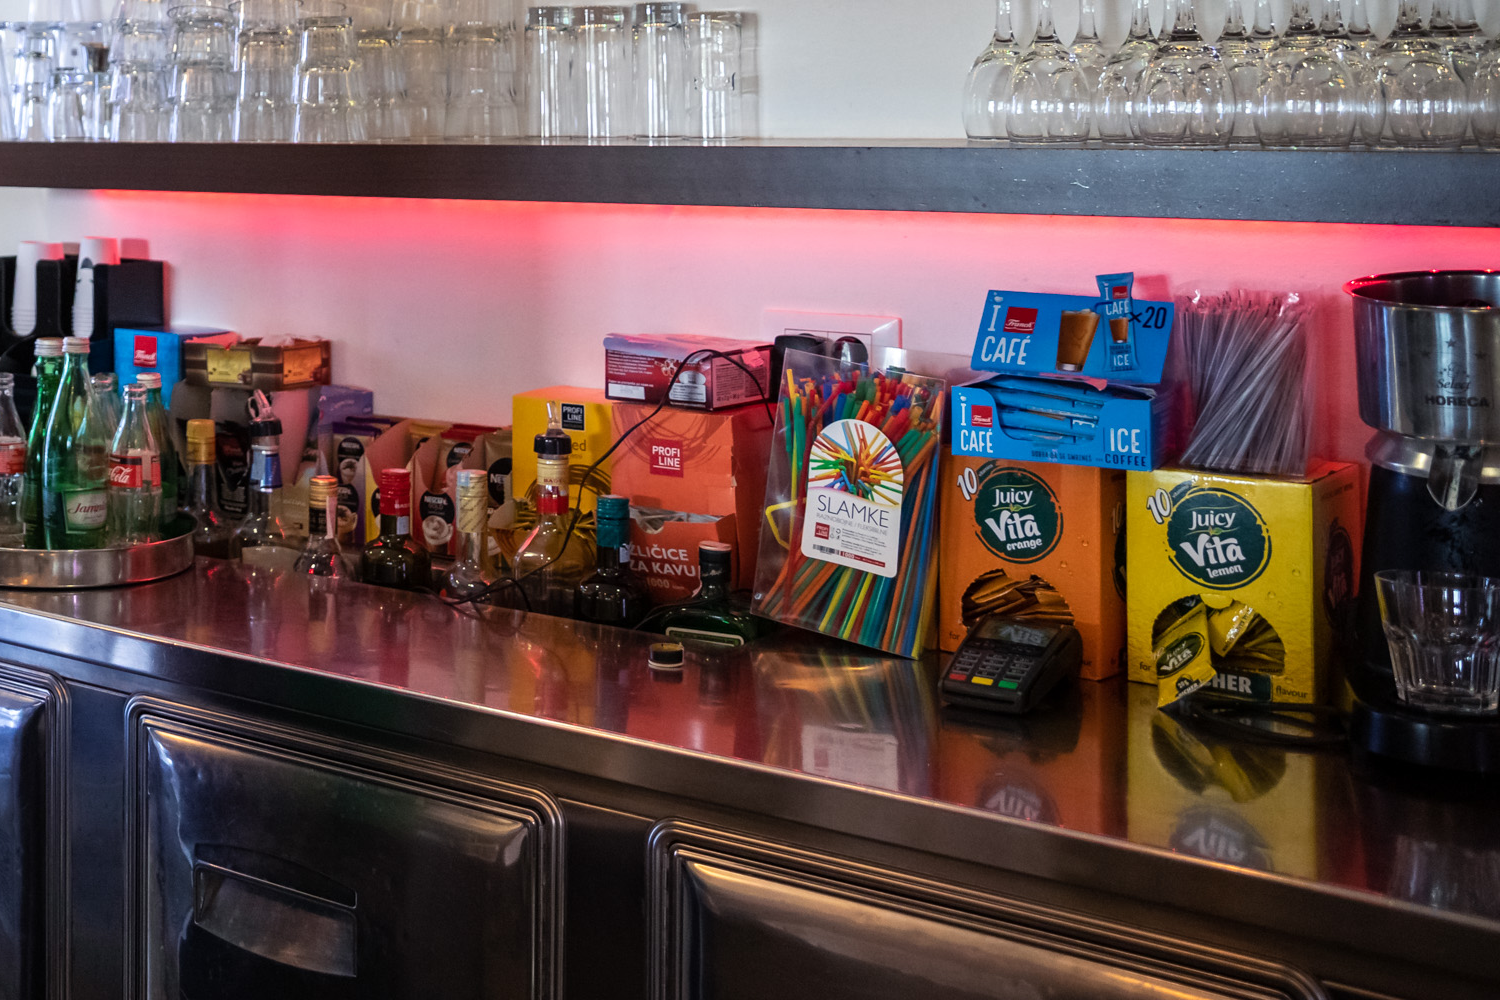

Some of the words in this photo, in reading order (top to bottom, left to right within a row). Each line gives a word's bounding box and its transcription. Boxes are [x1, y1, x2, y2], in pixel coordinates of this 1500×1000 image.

[981, 335, 1032, 366] CAFÉ
[1113, 354, 1130, 366] ICE
[1425, 395, 1489, 407] HORECA
[563, 406, 583, 414] PROFI
[567, 413, 583, 422] LINE
[960, 429, 994, 453] CAFÉ
[1110, 428, 1141, 453] ICE
[652, 445, 680, 458] PROFI
[658, 455, 681, 468] LINE
[1105, 453, 1147, 467] COFFEE
[957, 467, 978, 500] 10
[992, 489, 1034, 507] Juicy
[818, 494, 890, 529] SLAMKE
[1147, 488, 1172, 524] 10
[984, 510, 1042, 543] Vita
[1188, 511, 1236, 530] Juicy
[1006, 537, 1043, 551] orange
[1180, 533, 1246, 566] Vita
[652, 562, 696, 577] KAVU
[1206, 564, 1243, 578] lemon
[1140, 661, 1151, 672] for
[1275, 685, 1309, 699] flavour
